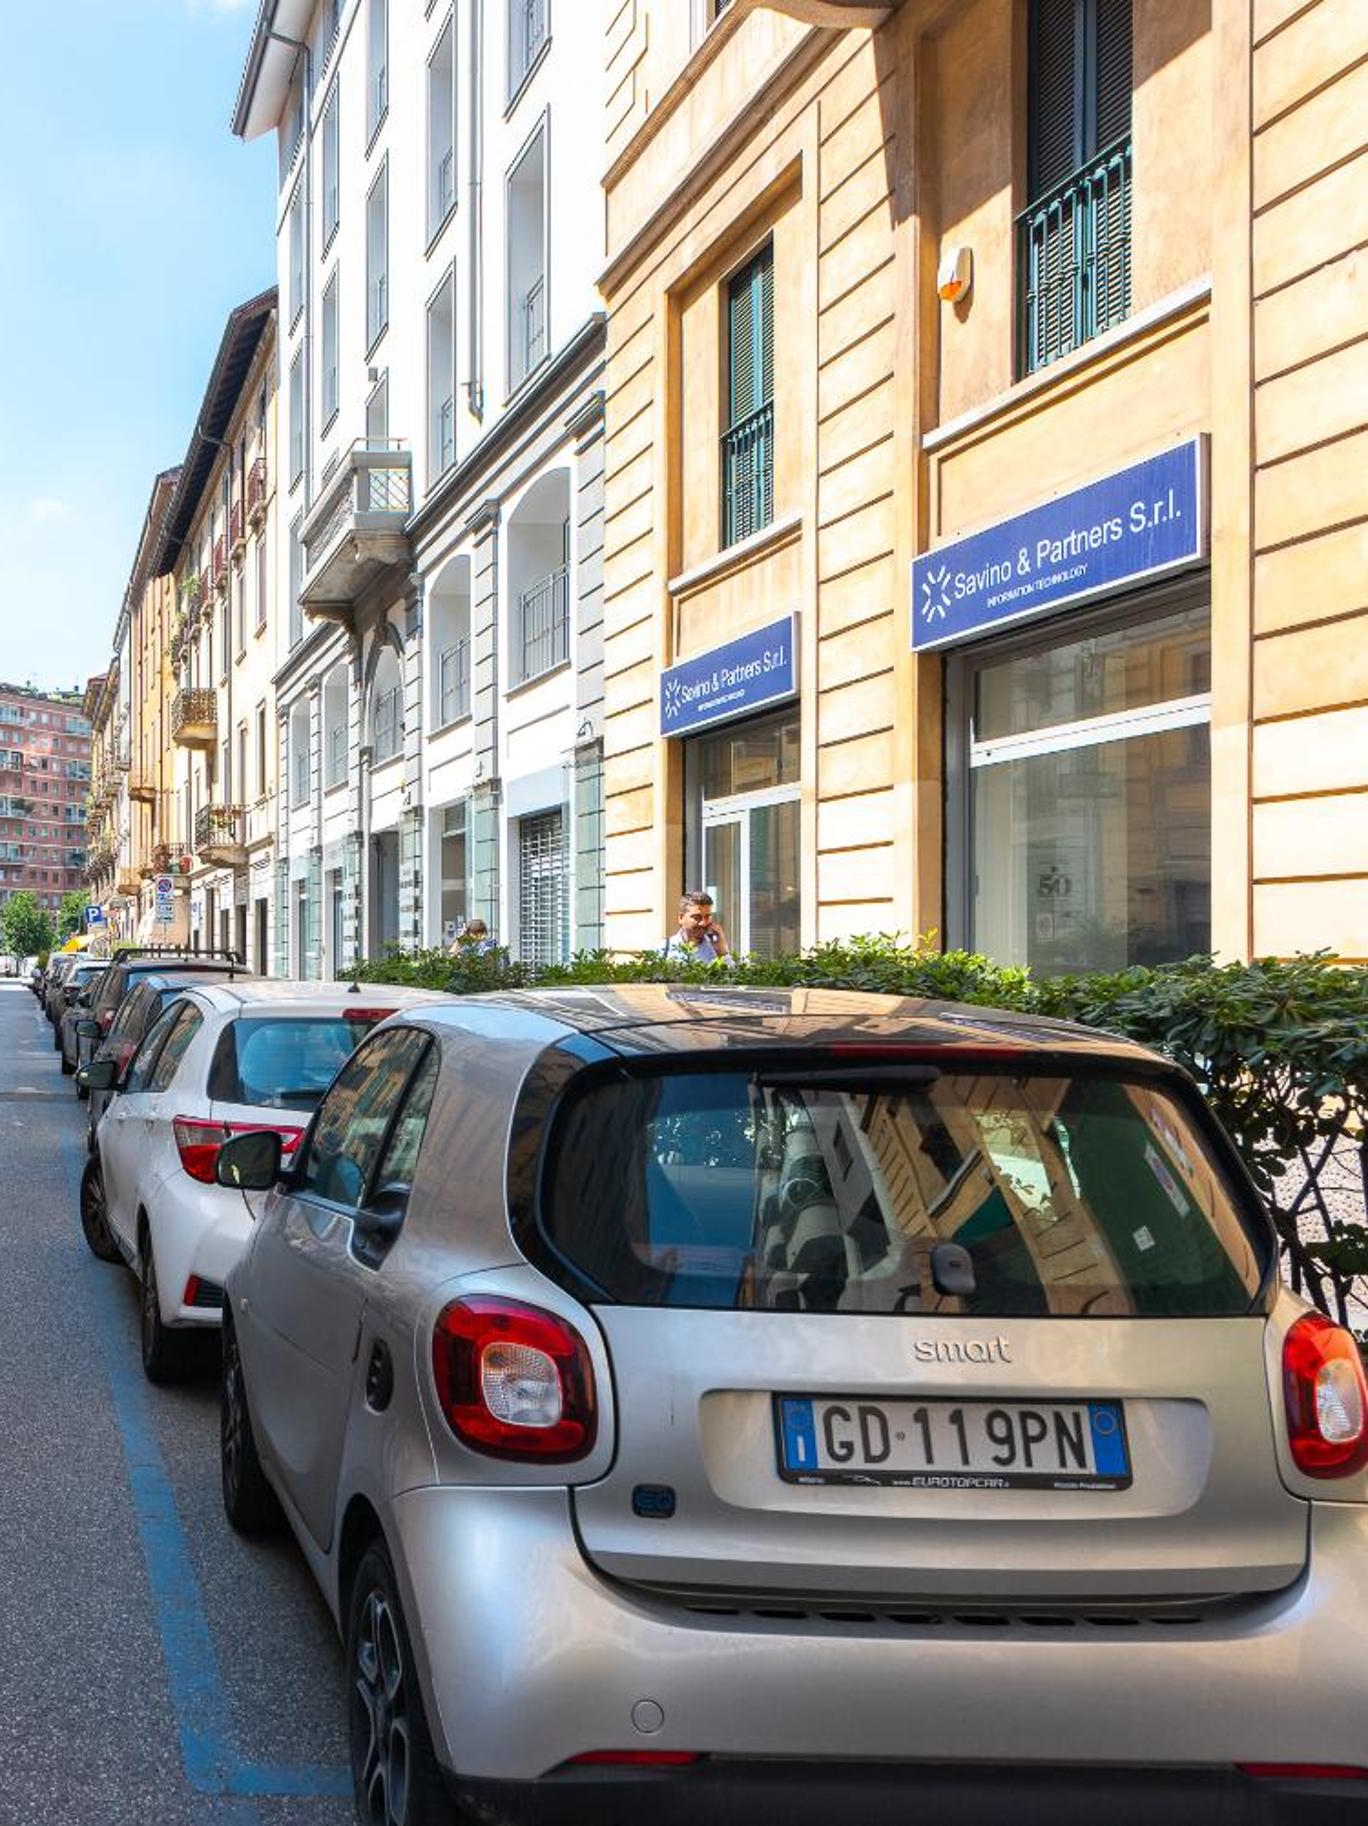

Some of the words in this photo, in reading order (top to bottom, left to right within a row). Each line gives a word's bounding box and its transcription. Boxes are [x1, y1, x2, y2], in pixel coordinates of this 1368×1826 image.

[954, 561, 1011, 600] Savino
[1017, 548, 1032, 576] &
[1037, 517, 1123, 569] Partners
[1130, 488, 1181, 534] S.r.l.
[682, 681, 710, 703] Savino
[712, 672, 719, 692] &
[721, 660, 762, 688] Partners
[88, 908, 99, 921] P
[913, 1336, 1012, 1363] smart
